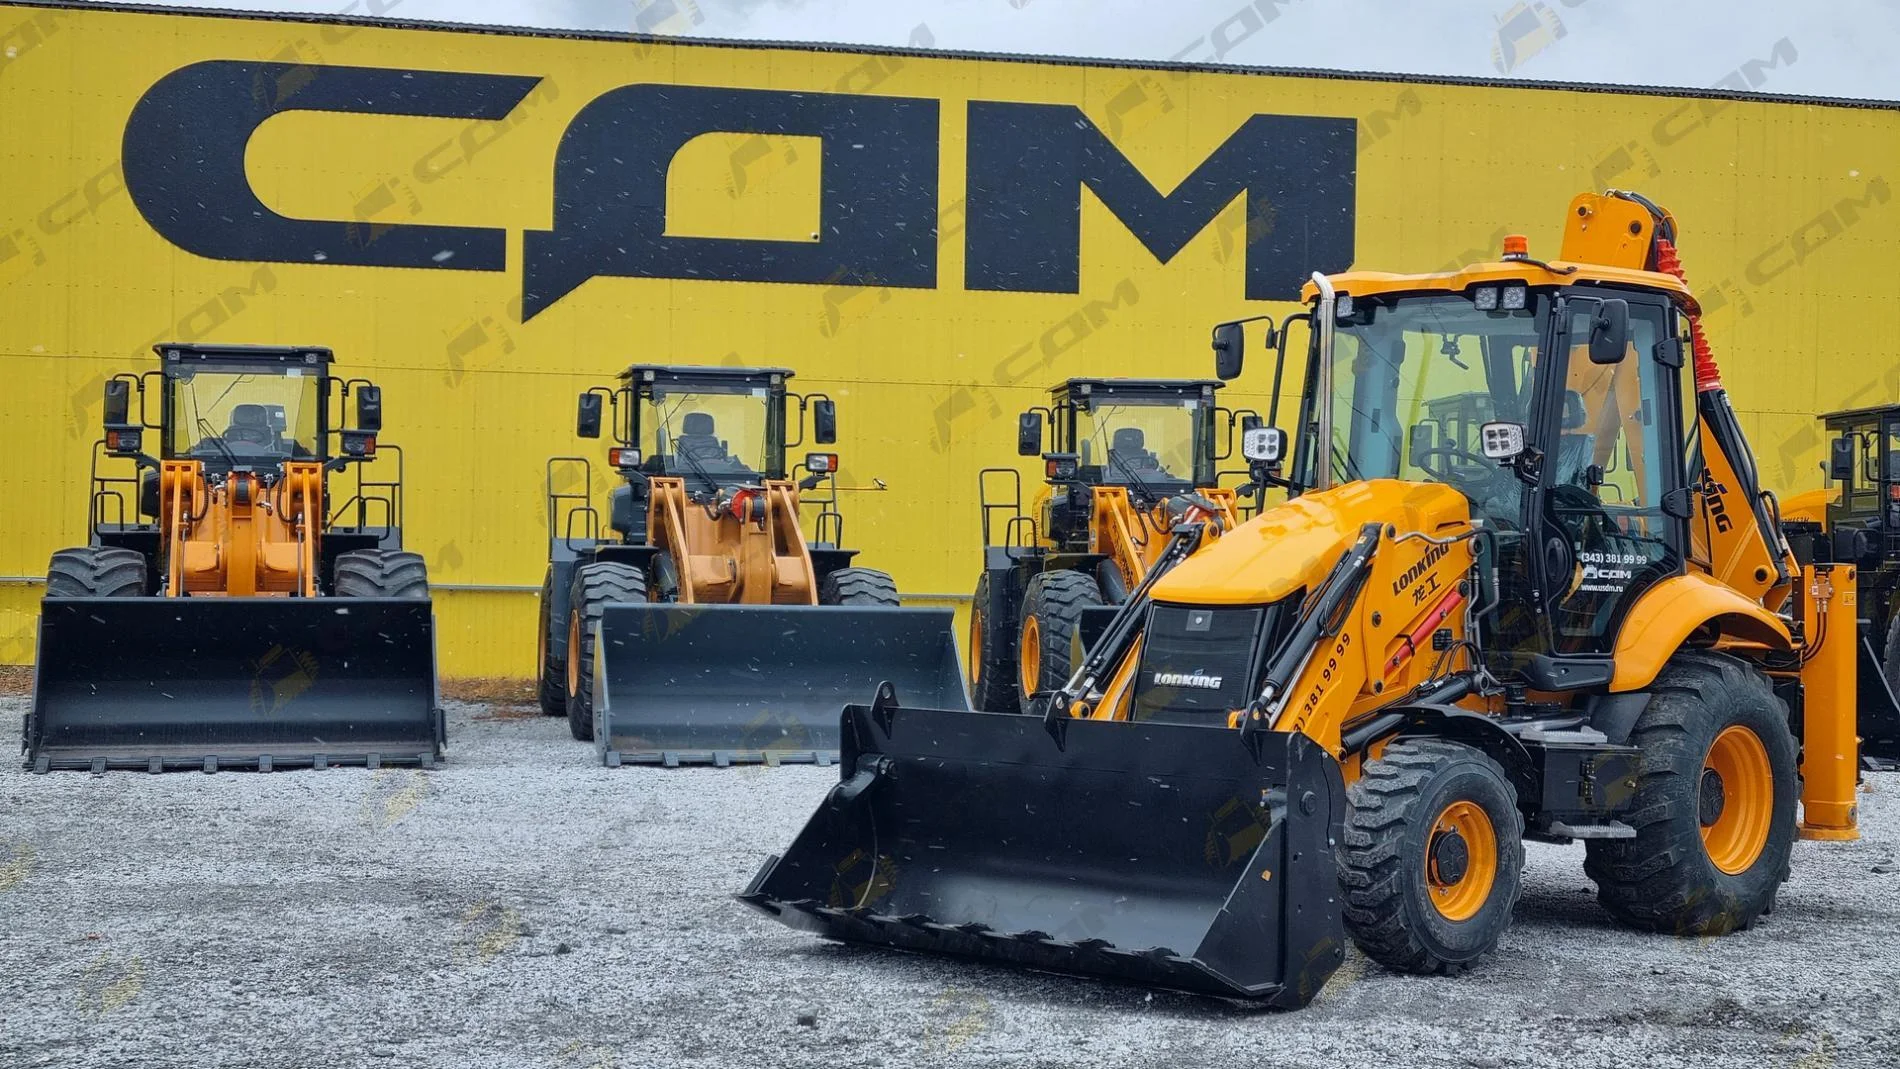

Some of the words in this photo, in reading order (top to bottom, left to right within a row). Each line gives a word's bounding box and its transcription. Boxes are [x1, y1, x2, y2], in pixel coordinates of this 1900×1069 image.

[1581, 552, 1604, 563] (343)
[1605, 554, 1621, 564] 381
[1623, 555, 1635, 564] 99
[1636, 555, 1647, 565] 99
[1581, 584, 1623, 593] www.usdm.ru
[1304, 683, 1324, 717] 381
[1322, 658, 1337, 682] 99
[1336, 632, 1351, 657] 99
